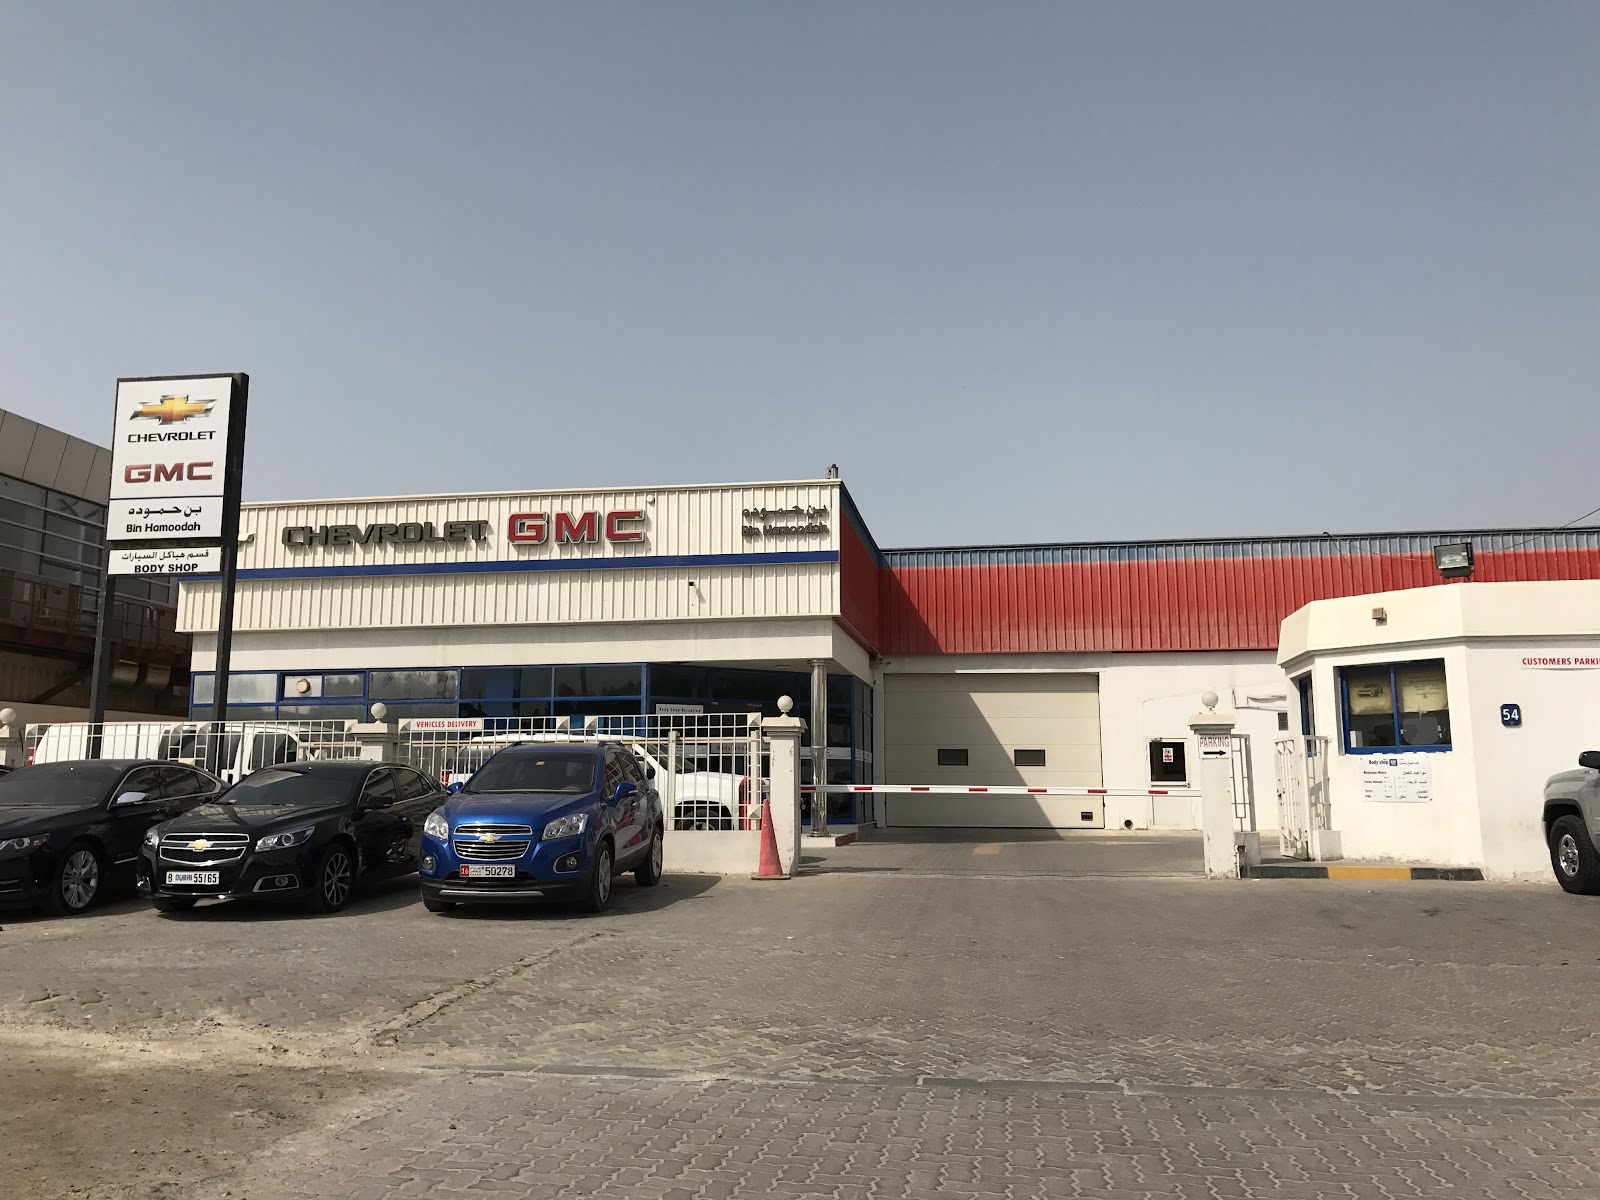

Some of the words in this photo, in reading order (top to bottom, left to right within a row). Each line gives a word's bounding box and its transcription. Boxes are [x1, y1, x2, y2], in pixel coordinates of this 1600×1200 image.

[127, 430, 216, 443] CHEVROLET
[124, 461, 213, 484] GMC
[183, 505, 202, 518] بن
[126, 523, 142, 533] Bin
[144, 521, 201, 532] Hamoodah
[282, 519, 489, 547] CHEVROLET
[507, 508, 647, 545] GMC
[741, 525, 760, 536] Bin
[763, 521, 829, 536] Hamoodah
[121, 551, 158, 562] السيارات
[159, 551, 186, 561] هياكل
[187, 549, 209, 560] قسم
[134, 564, 165, 573] BODY
[168, 563, 199, 572] SHOP
[1522, 657, 1572, 666] CUSTOMERS
[1574, 657, 1600, 666] PARKI
[1502, 708, 1519, 721] 54
[416, 720, 445, 728] VEHICLES
[447, 720, 477, 728] DELIVERY
[1199, 736, 1230, 748] PARKING
[461, 867, 469, 875] 16
[485, 866, 513, 876] 50278
[193, 873, 217, 883] 55165
